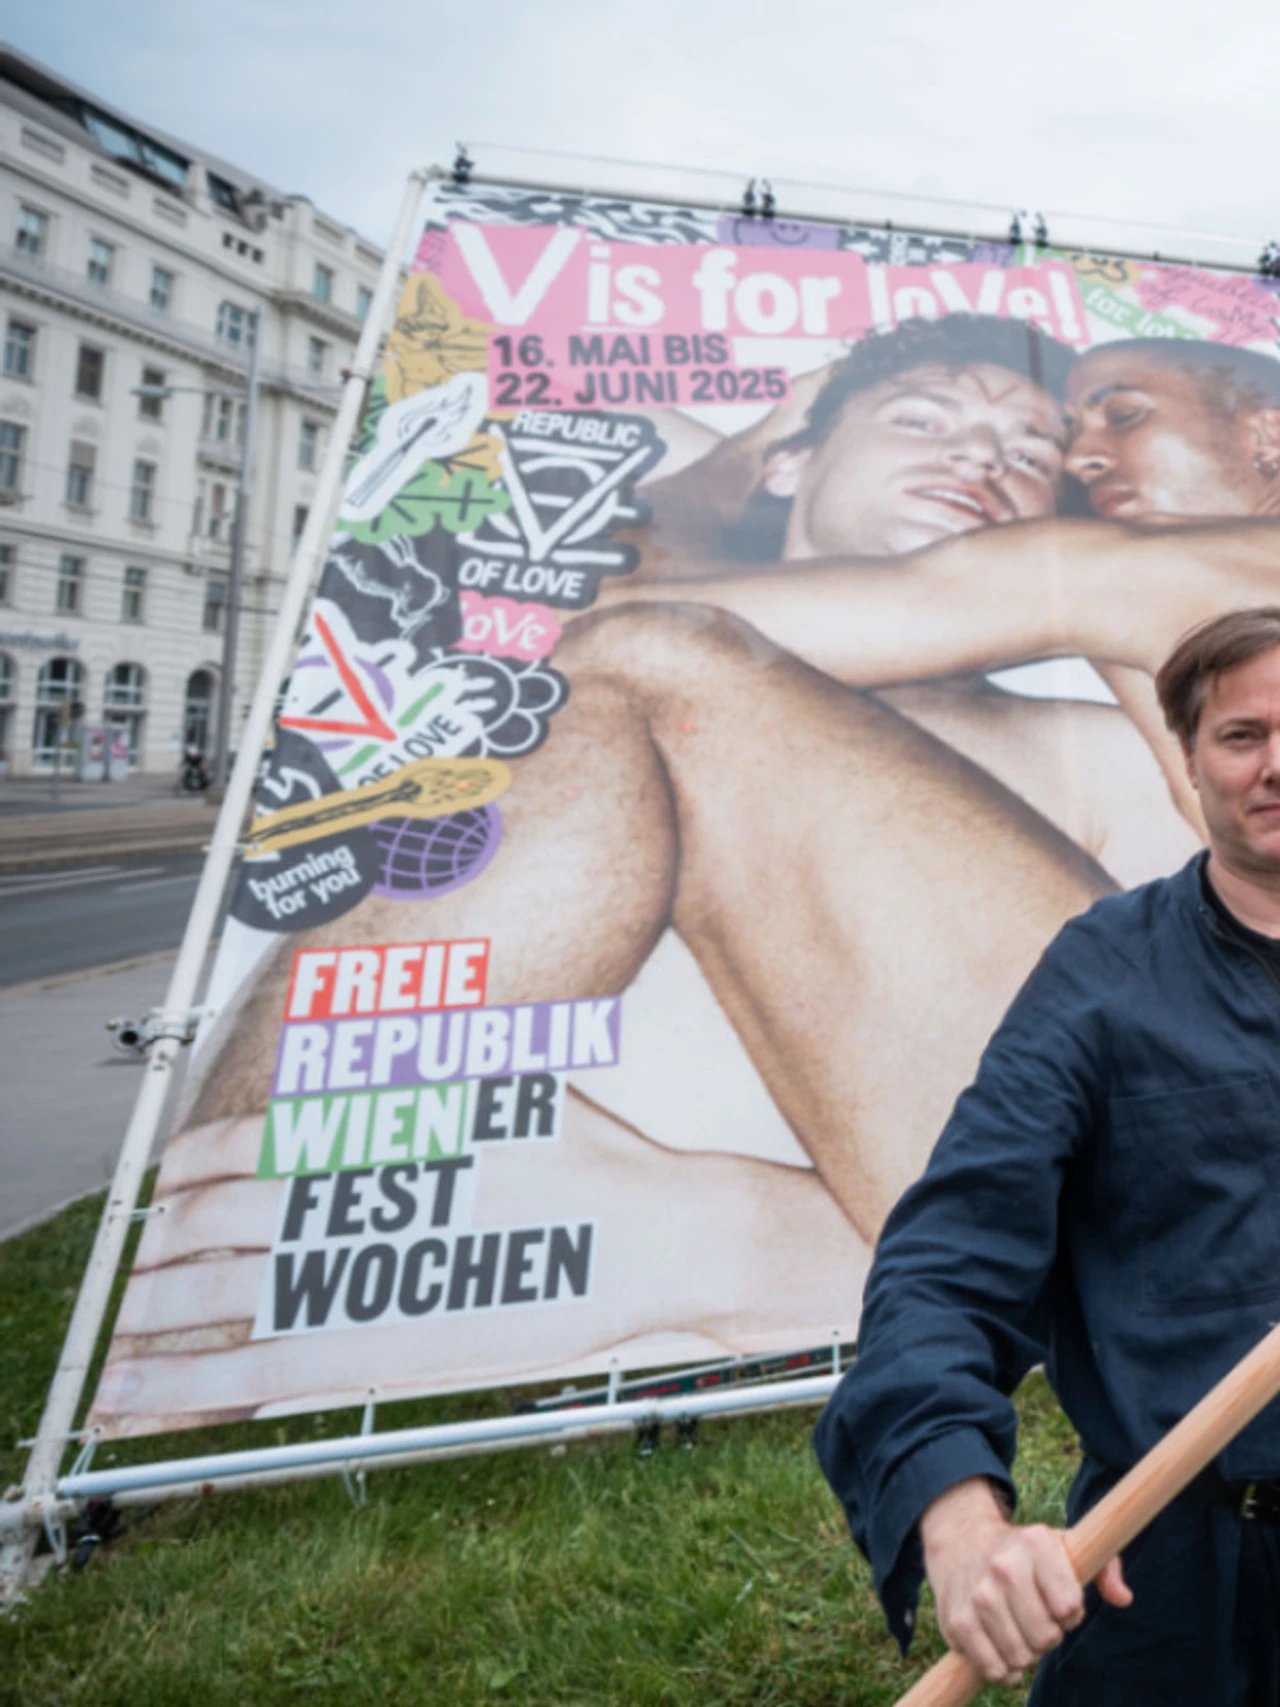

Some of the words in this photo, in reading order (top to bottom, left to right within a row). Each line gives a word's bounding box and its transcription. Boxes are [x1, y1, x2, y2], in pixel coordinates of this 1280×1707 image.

[451, 221, 582, 327] V
[586, 244, 665, 330] is
[691, 249, 841, 335] for
[492, 335, 555, 368] 16.
[568, 334, 651, 368] MAI
[663, 333, 729, 366] BIS
[495, 372, 563, 406] 22.
[573, 370, 678, 405] JUNI
[689, 368, 788, 402] 2025
[510, 410, 642, 448] REPUBLIC
[458, 557, 505, 589] OF
[503, 562, 587, 599] LOVE
[248, 845, 356, 900] burning
[265, 889, 307, 920] for
[309, 866, 362, 905] you
[287, 941, 487, 1019] FREIE
[275, 1000, 616, 1094] REPUBLIK
[271, 1073, 558, 1174] WIENER
[280, 1155, 475, 1242] FEST
[273, 1223, 594, 1332] WOCHEN
